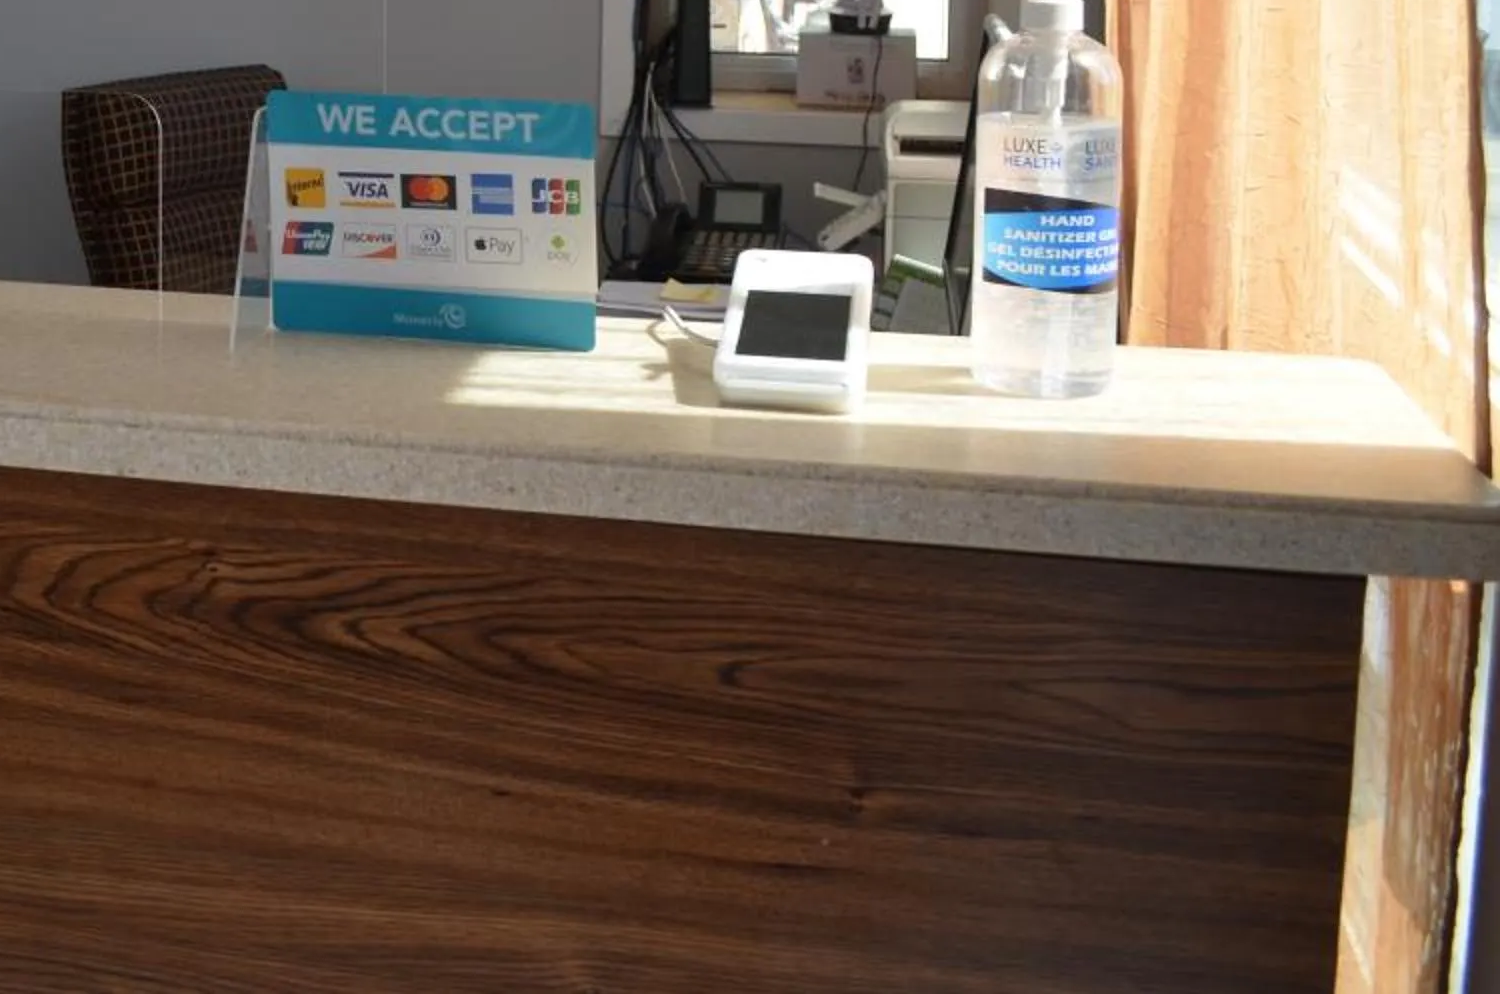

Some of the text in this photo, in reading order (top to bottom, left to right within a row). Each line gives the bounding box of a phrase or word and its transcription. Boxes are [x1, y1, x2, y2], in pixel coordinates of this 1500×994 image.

[316, 103, 540, 143] WE ACCEPT
[1003, 136, 1048, 154] LUXE
[1003, 156, 1061, 169] HEALTH
[346, 181, 389, 199] VISA
[1040, 214, 1095, 227] HAND
[343, 231, 393, 244] DISCOVER
[1003, 228, 1096, 243] SANITIZER
[489, 236, 515, 256] Pay
[996, 259, 1045, 276] POUR
[1049, 265, 1081, 277] LES
